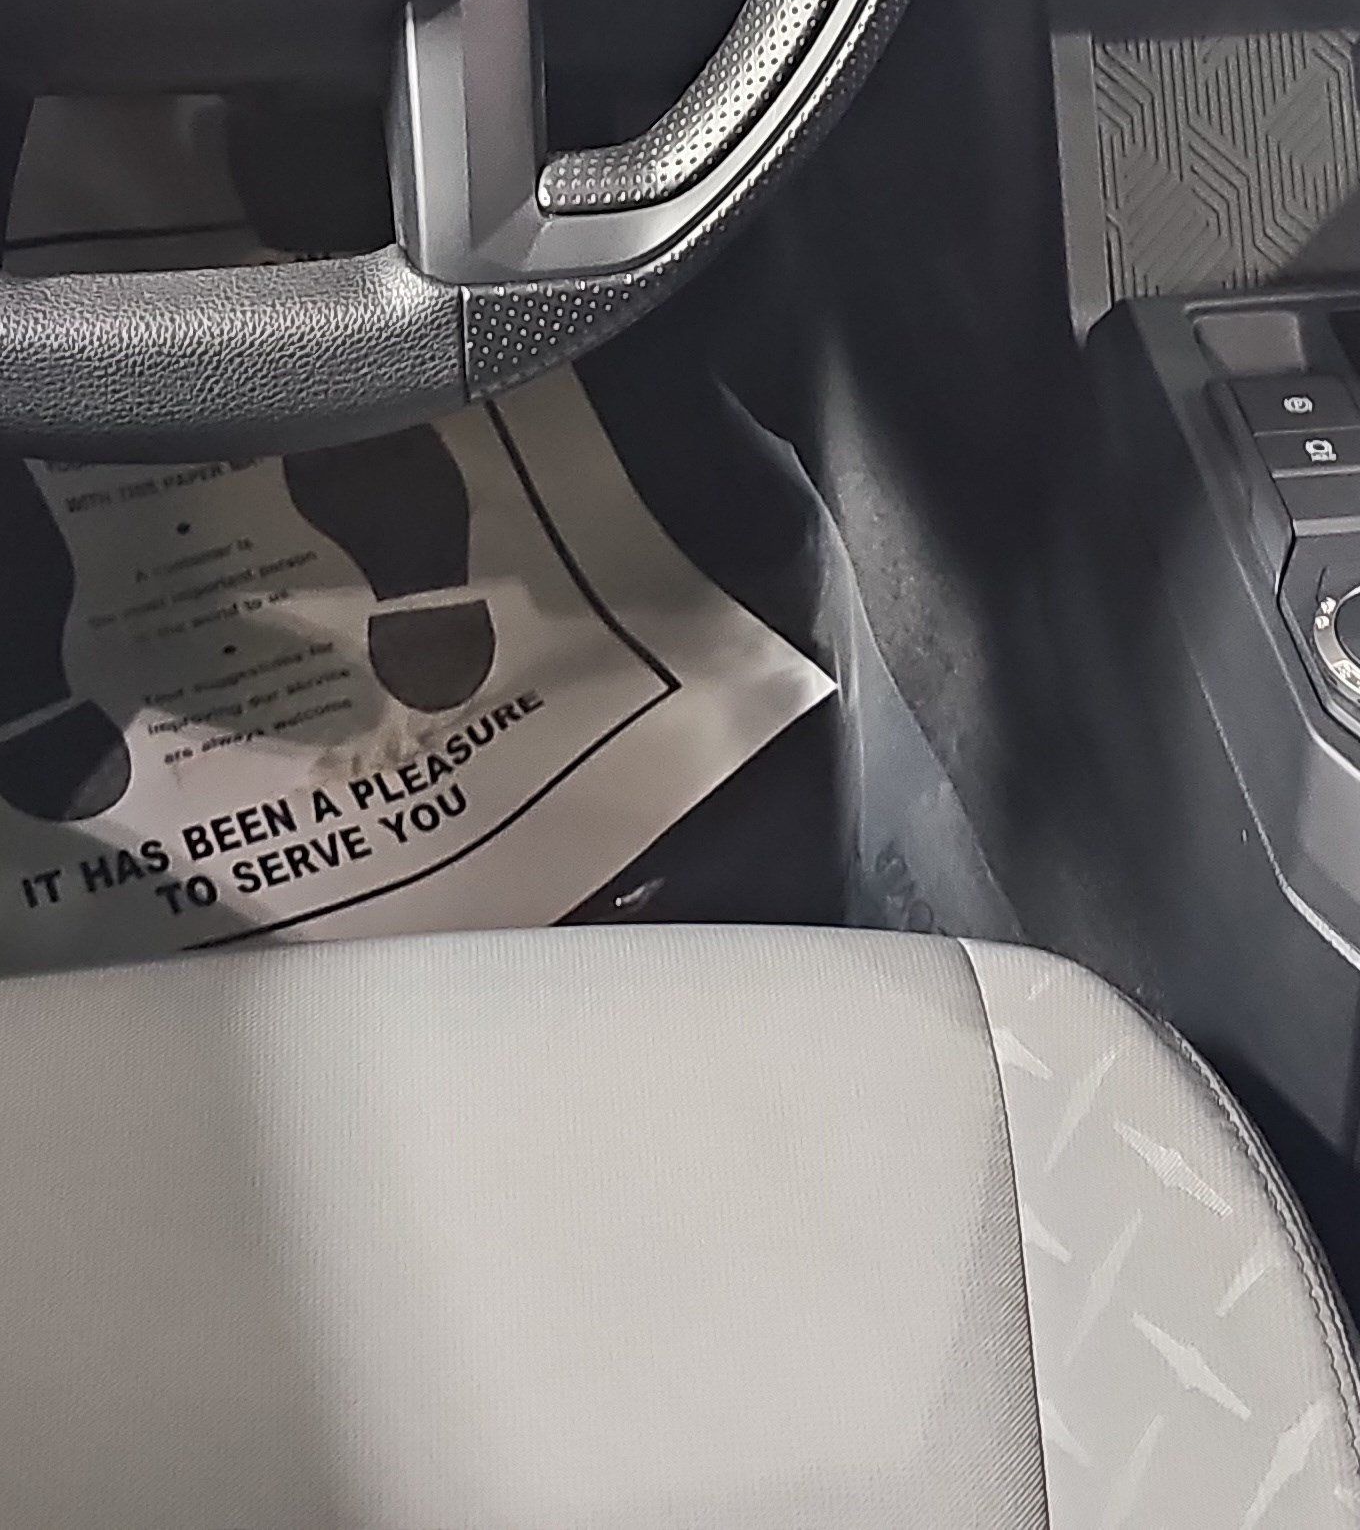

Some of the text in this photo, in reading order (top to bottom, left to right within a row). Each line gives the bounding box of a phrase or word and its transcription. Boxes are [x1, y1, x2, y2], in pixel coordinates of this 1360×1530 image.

[21, 689, 545, 909] IT HAS BEEN A PLEASURE
[200, 727, 266, 753] always
[154, 783, 469, 917] TO SERVE YOU
